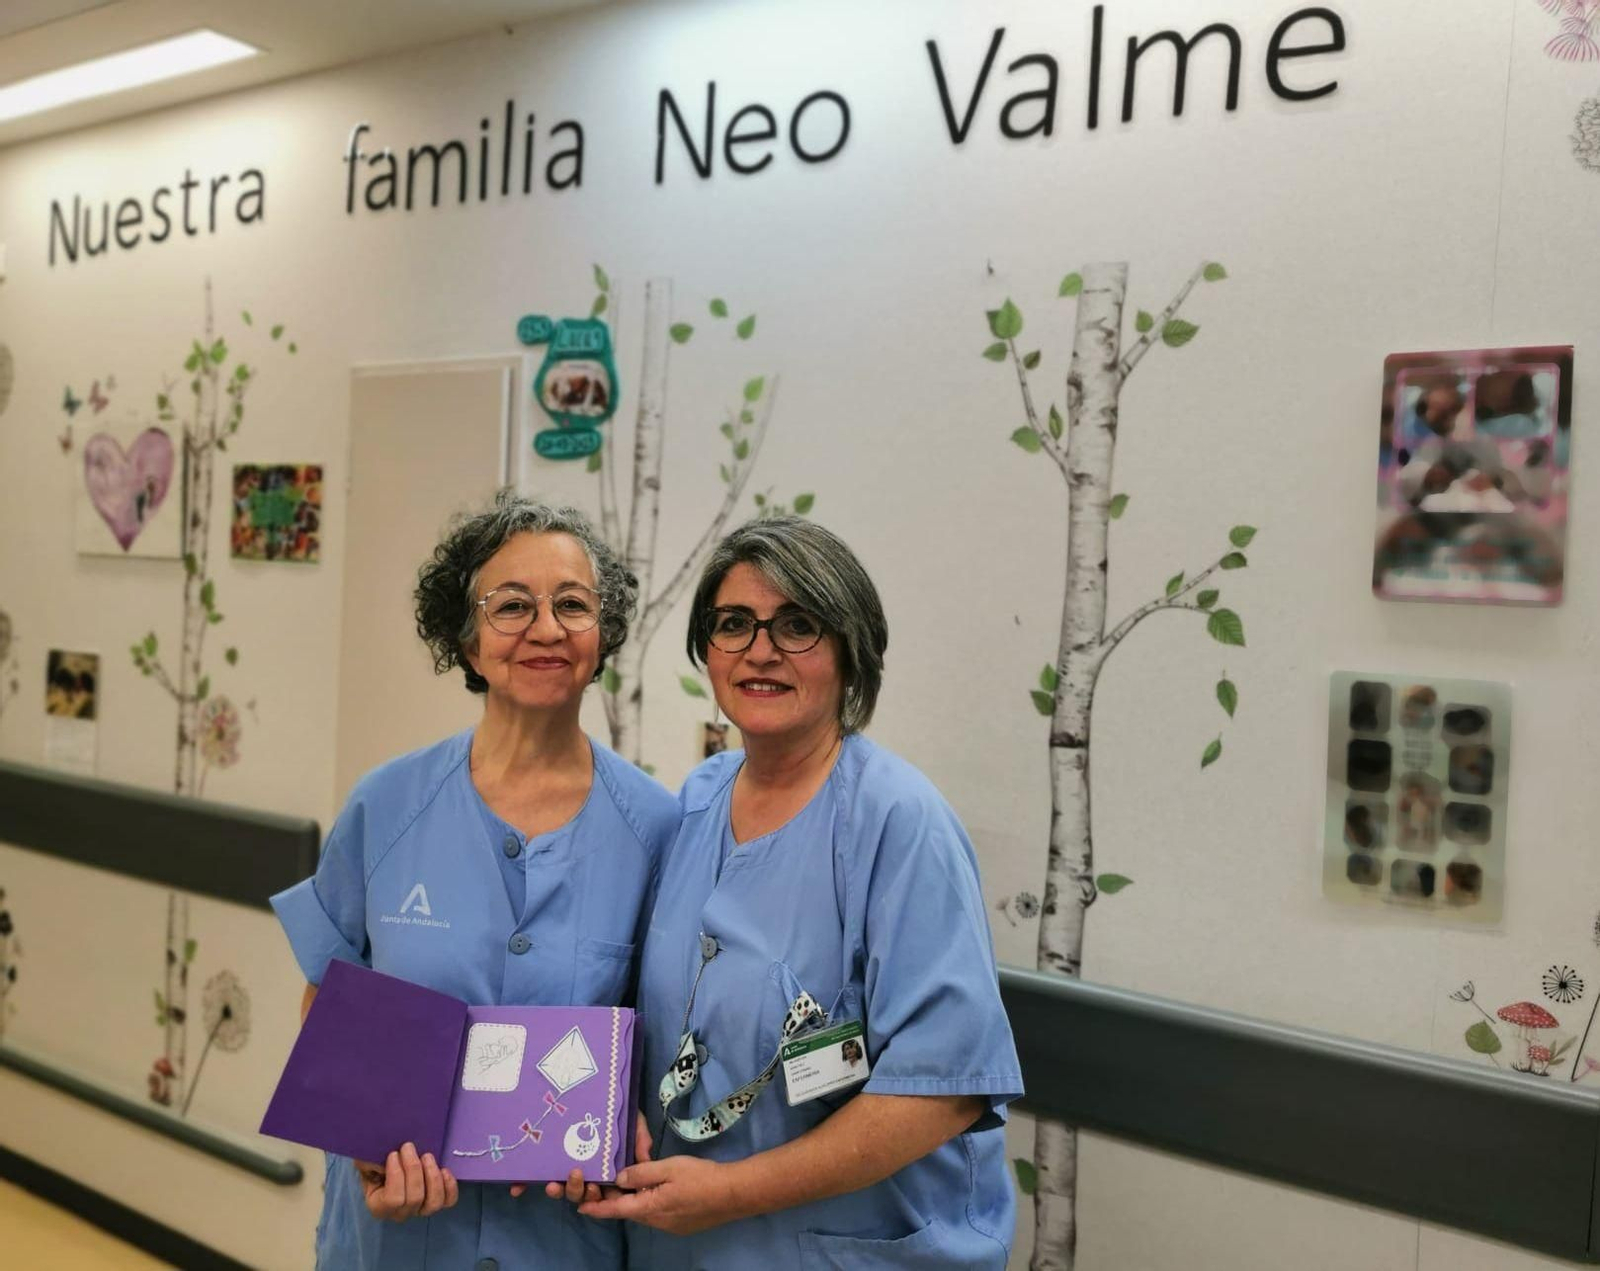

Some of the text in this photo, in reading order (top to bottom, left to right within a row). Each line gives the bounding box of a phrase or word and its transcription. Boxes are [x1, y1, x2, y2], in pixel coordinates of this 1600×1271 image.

[49, 4, 1346, 266] Nuestra familia Neo Valme
